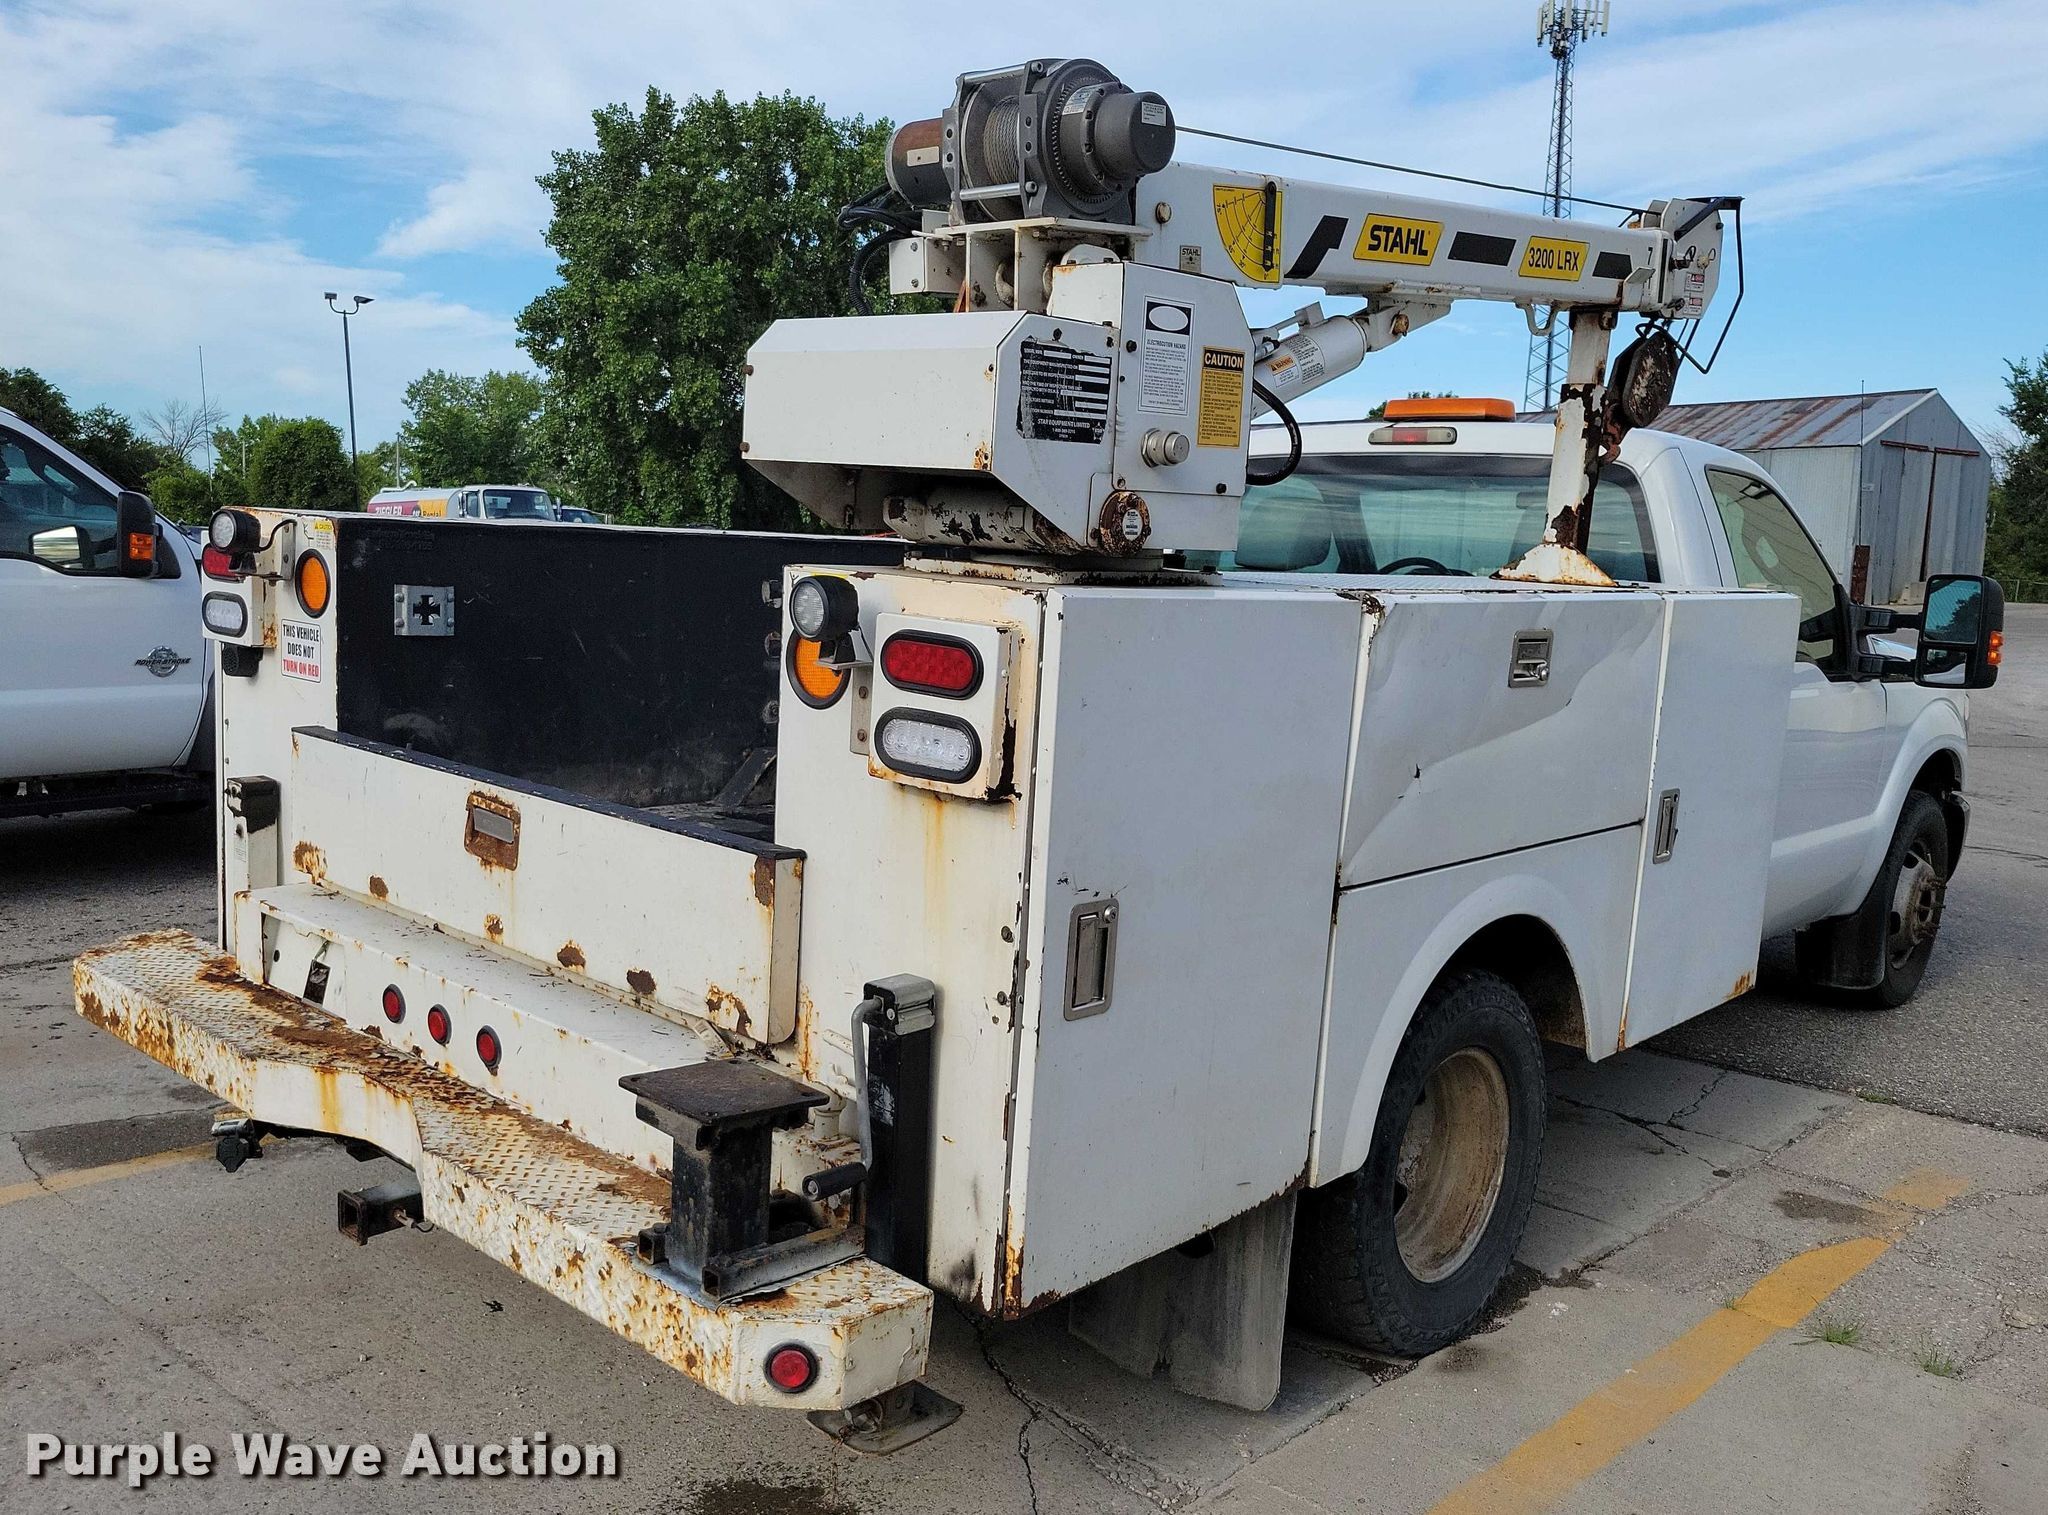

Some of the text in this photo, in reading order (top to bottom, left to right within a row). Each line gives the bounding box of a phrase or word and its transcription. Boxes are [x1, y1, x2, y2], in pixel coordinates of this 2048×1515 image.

[1367, 224, 1429, 257] STAHL
[1181, 247, 1201, 257] STAHL
[1527, 246, 1580, 272] 3200 LRX
[1146, 339, 1173, 348] ELECTROCUTION
[1204, 352, 1244, 369] CAUTION
[1048, 419, 1074, 427] EQUIPMENT
[375, 505, 403, 516] ZIEGLER
[282, 624, 320, 642] THIS VEHICLE
[287, 642, 315, 659] DOES NOT
[283, 659, 320, 677] TURN ON RED
